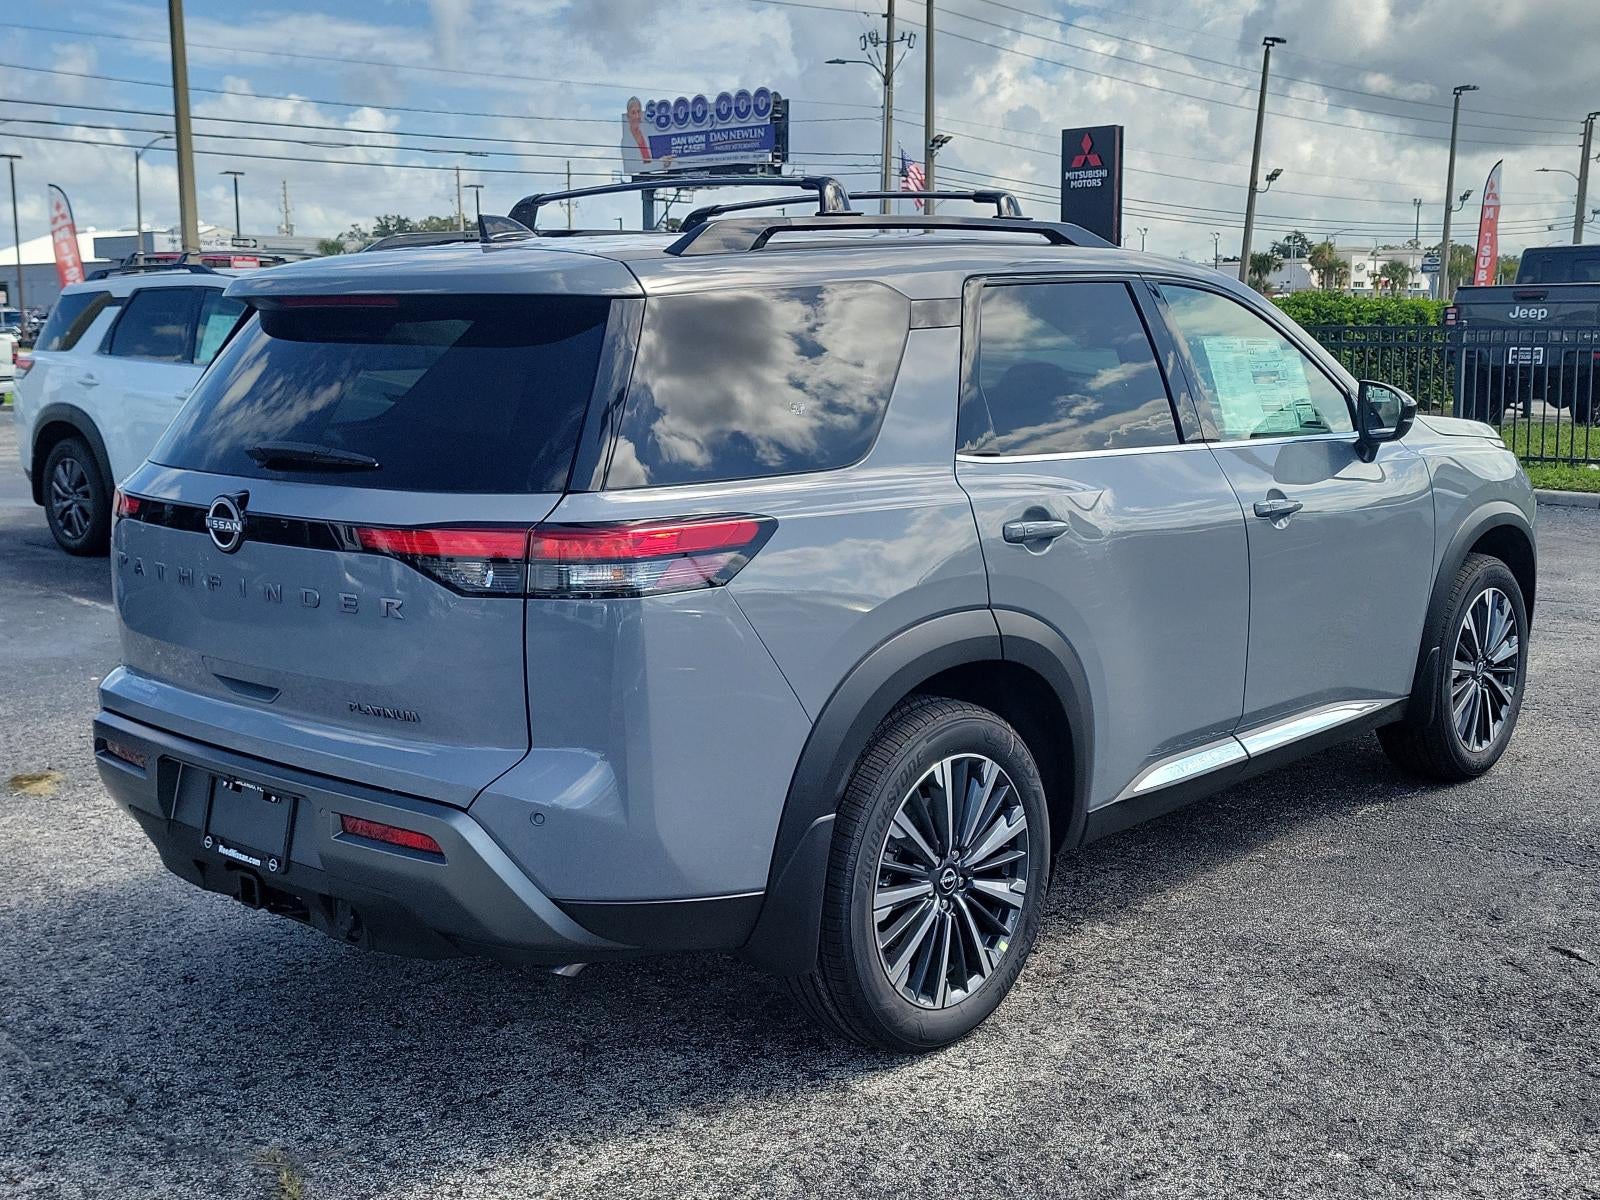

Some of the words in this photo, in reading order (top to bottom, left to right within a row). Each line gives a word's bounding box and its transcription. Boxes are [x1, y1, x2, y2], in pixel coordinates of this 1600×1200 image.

[645, 87, 772, 131] $800,000
[671, 137, 687, 146] DAN
[709, 130, 729, 142] DAN
[728, 128, 765, 141] NEWLIN
[1065, 169, 1108, 180] MITSUBISHI
[1070, 178, 1102, 189] MOTORS
[1508, 305, 1548, 321] Jeep
[206, 517, 241, 532] NISSAN
[117, 550, 405, 620] PATHFINDER
[347, 700, 421, 723] PLATINUM
[863, 752, 928, 890] BRIDGESTONE
